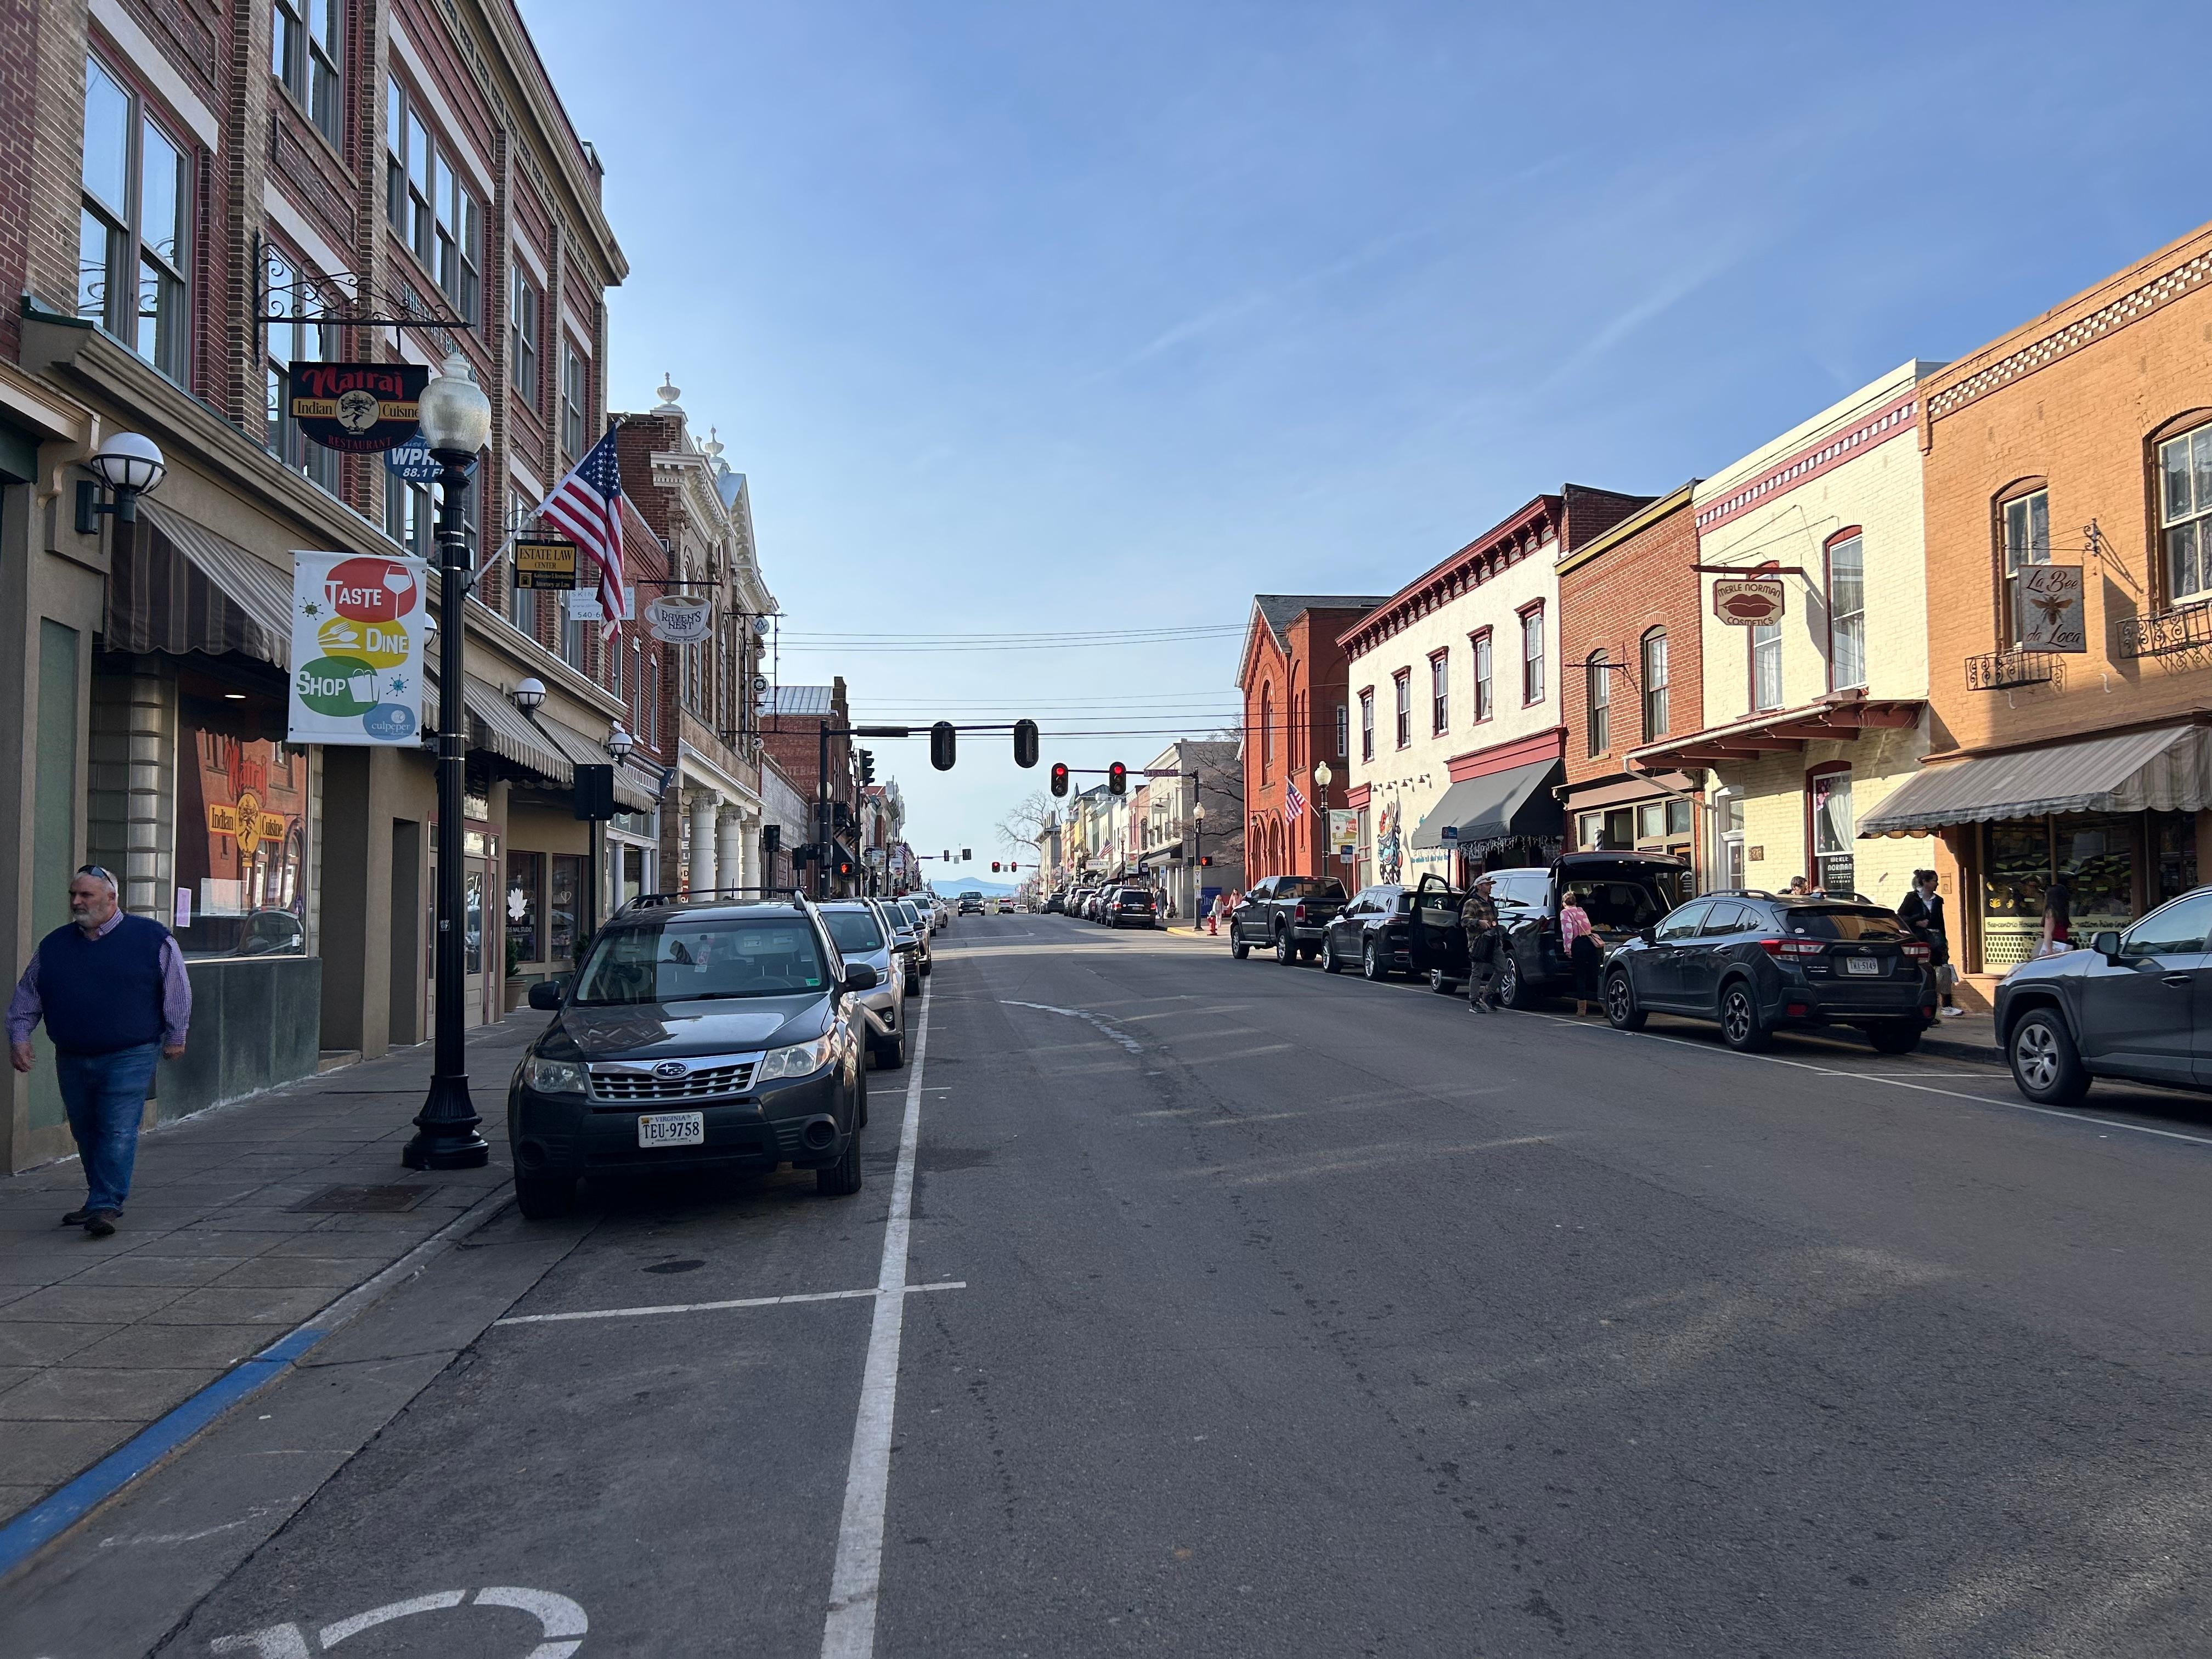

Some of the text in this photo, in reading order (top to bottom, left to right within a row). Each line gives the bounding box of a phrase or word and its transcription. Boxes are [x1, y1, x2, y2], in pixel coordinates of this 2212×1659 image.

[302, 366, 403, 399] Natraj
[297, 400, 420, 417] Indian Cuisine
[328, 435, 392, 450] RESTAURANT
[392, 448, 442, 466] WPR
[403, 468, 428, 477] 88.1
[520, 548, 573, 561] ESTATE LAW
[2026, 569, 2078, 593] La Bee
[1718, 584, 1781, 597] MERLE NORMAN
[661, 609, 701, 622] RAVEN'S
[1727, 617, 1773, 625] COSMETICS
[2027, 624, 2081, 647] da Loca
[371, 721, 411, 732] culpeper
[212, 808, 283, 837] Indian Cuisine
[642, 1121, 699, 1138] TEU-9758
